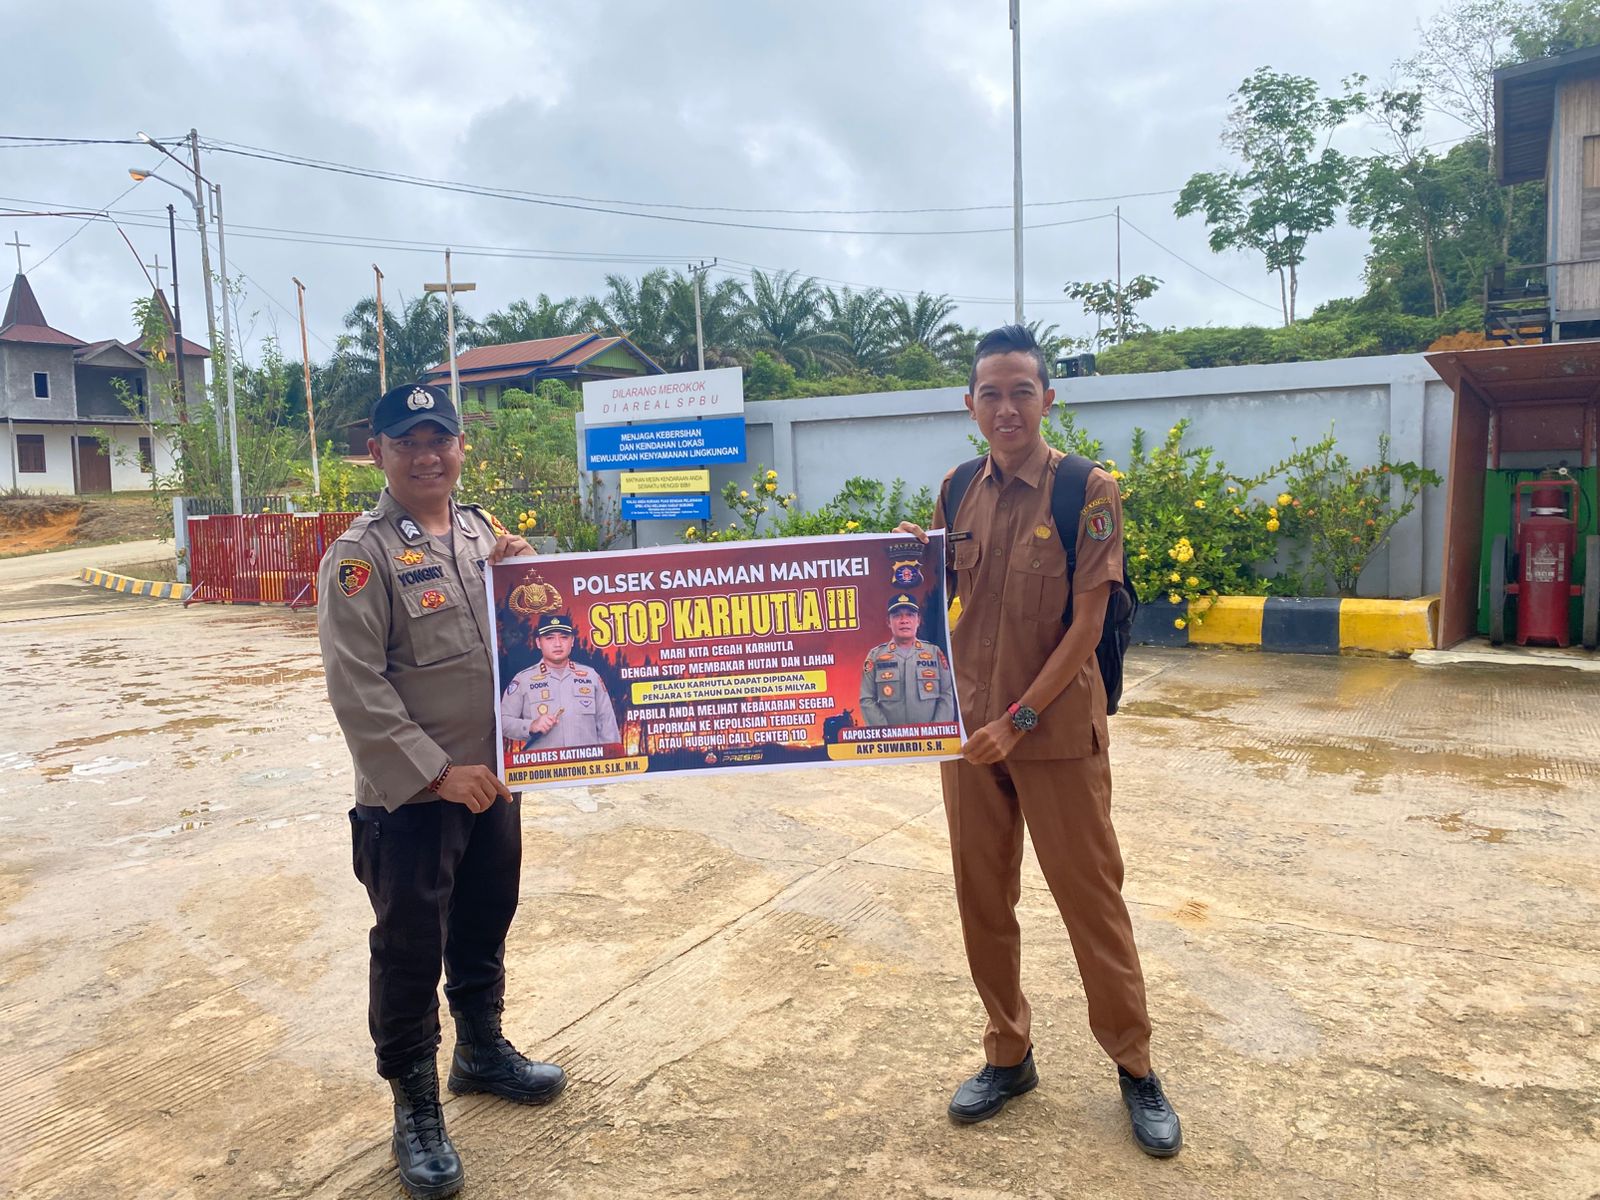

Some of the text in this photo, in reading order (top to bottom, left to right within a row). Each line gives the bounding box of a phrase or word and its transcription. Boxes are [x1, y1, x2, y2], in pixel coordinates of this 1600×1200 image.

[612, 381, 705, 399] DILARANG MEROKOK
[677, 394, 719, 408] SPBU
[620, 428, 702, 442] MENJAGA KEBERSIHAN
[620, 438, 704, 452] DAN KEINDAHAN LOKASI
[590, 446, 739, 463] MEWUJUDKAN KENYAMANAN LINGKUNGAN
[398, 565, 444, 586] YONGKY
[573, 557, 870, 596] POLSEK SANAMAN MANTIKEI
[590, 588, 858, 647] STOP KARHUTLA !!!
[660, 641, 794, 660] MARI KITA CEGAH KARHUTLA
[621, 654, 834, 679] DENGAN STOP MEMBAKAR HUTAN DAN LAHAN
[530, 682, 549, 690] DODIK
[653, 674, 805, 691] PELAKU KARHUTLA DAPAT DIPIDANA
[642, 683, 817, 701] PENJARA 15 TAHUN DAN DENDA 15 MILYAR
[627, 697, 834, 721] APABILA ANDA MELIHAT KEBAKARAN SEGERA
[647, 713, 816, 735] LAPORKAN KE KEPOLISIAN TERDEKAT
[842, 725, 958, 740] KAPOLSEK SANAMAN MANTIKEI
[658, 729, 806, 749] ATAU HUBUNGI CALL CENTER 110
[856, 741, 945, 754] AKP SUWARDI, S.H.
[512, 747, 604, 764] KAPOLRES KATINGAN
[508, 772, 528, 782] AKBP
[530, 770, 552, 780] DODIK
[553, 767, 589, 778] HARTONO,
[625, 761, 640, 771] M.H.
